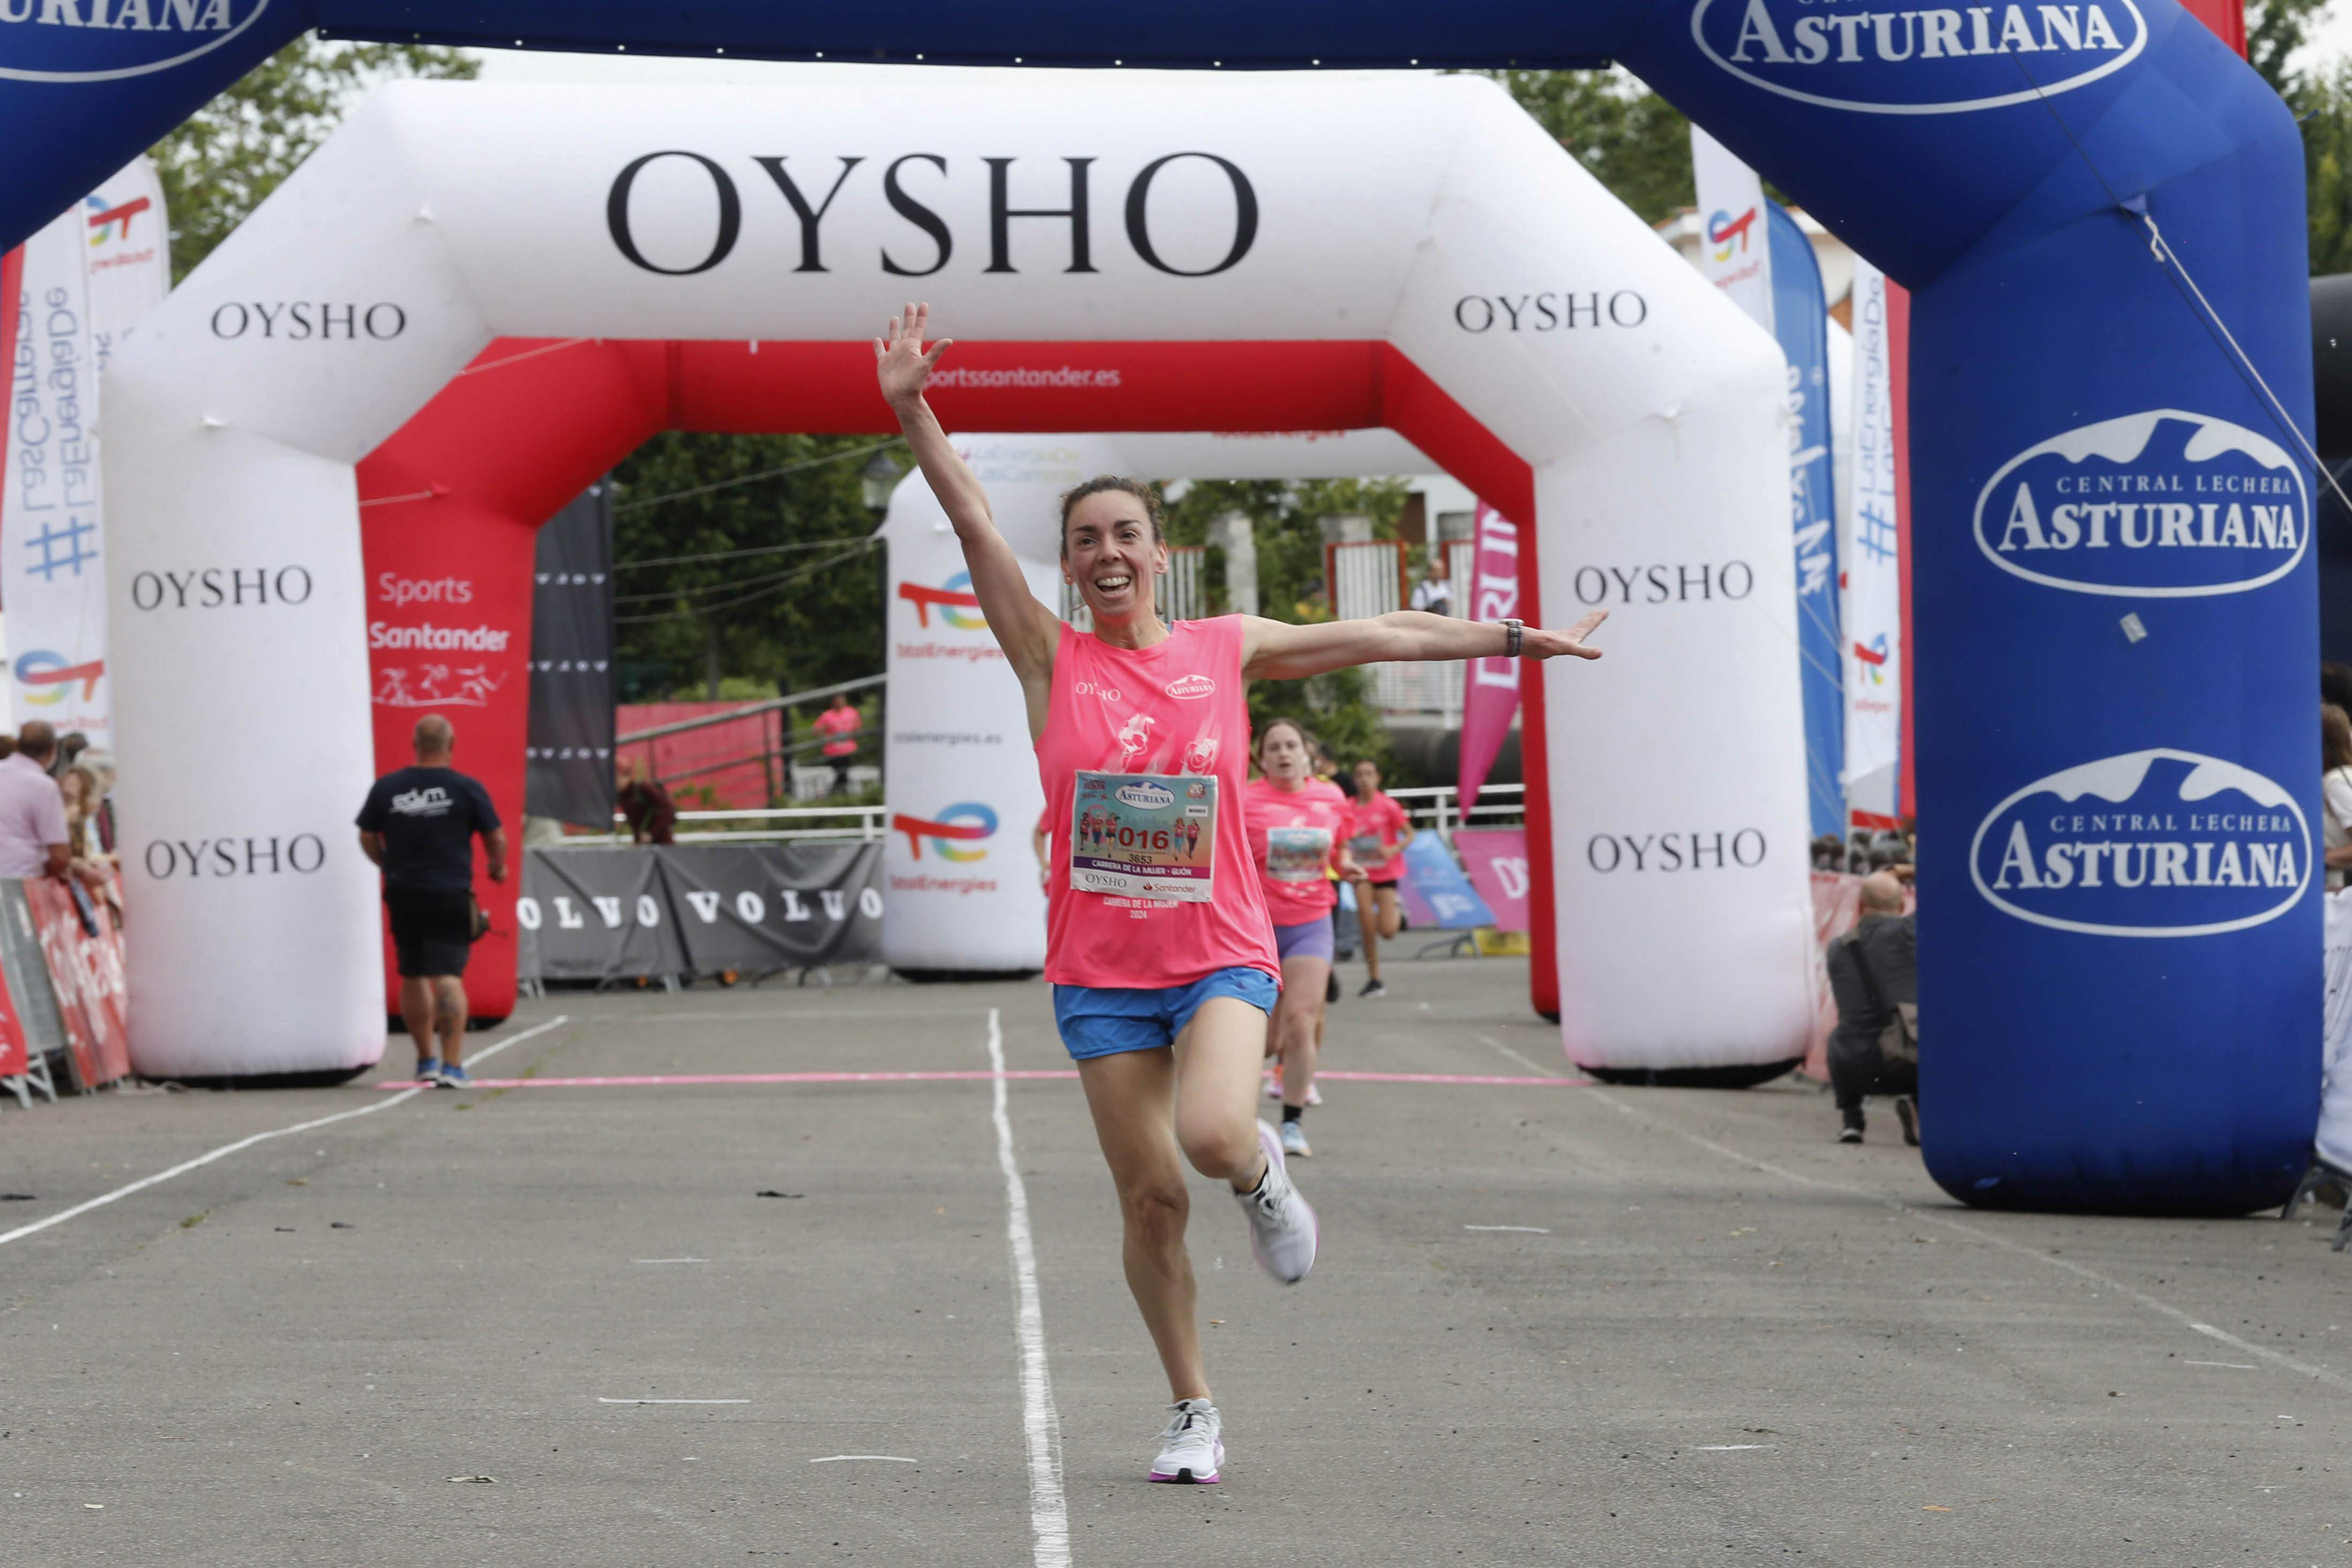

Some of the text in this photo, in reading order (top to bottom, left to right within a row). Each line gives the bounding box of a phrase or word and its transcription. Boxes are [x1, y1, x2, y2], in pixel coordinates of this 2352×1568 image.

[1729, 0, 2124, 64] ASTURIANA
[606, 150, 1259, 277] OYSHO
[211, 302, 406, 340] OYSHO
[1455, 289, 1646, 334] OYSHO
[923, 366, 1121, 390] portssantander.es
[2057, 475, 2290, 495] CENTRAL LECHERA
[1998, 482, 2297, 551] ASTURIANA
[132, 565, 313, 611] OYSHO
[379, 573, 473, 606] Sports
[1574, 560, 1753, 606] OYSHO
[369, 622, 509, 652] Santander
[1120, 789, 1171, 804] ASTURIANA
[1119, 827, 1169, 849] 016
[2051, 814, 2290, 832] CENTRAL LECHERA
[145, 833, 326, 880] OYSHO
[1129, 853, 1152, 864] 3653
[1588, 827, 1766, 874] OYSHO
[1992, 820, 2298, 890] ASTURIANA
[1085, 874, 1127, 888] OYSHO
[1092, 860, 1122, 870] CARRERA
[1132, 866, 1141, 874] LA
[1143, 867, 1166, 875] MUJER
[1103, 897, 1178, 908] CARRERA DE LA MUJER
[1154, 884, 1196, 893] Santander
[517, 887, 884, 929] OLVO VOLVO
[1130, 910, 1147, 919] 2024
